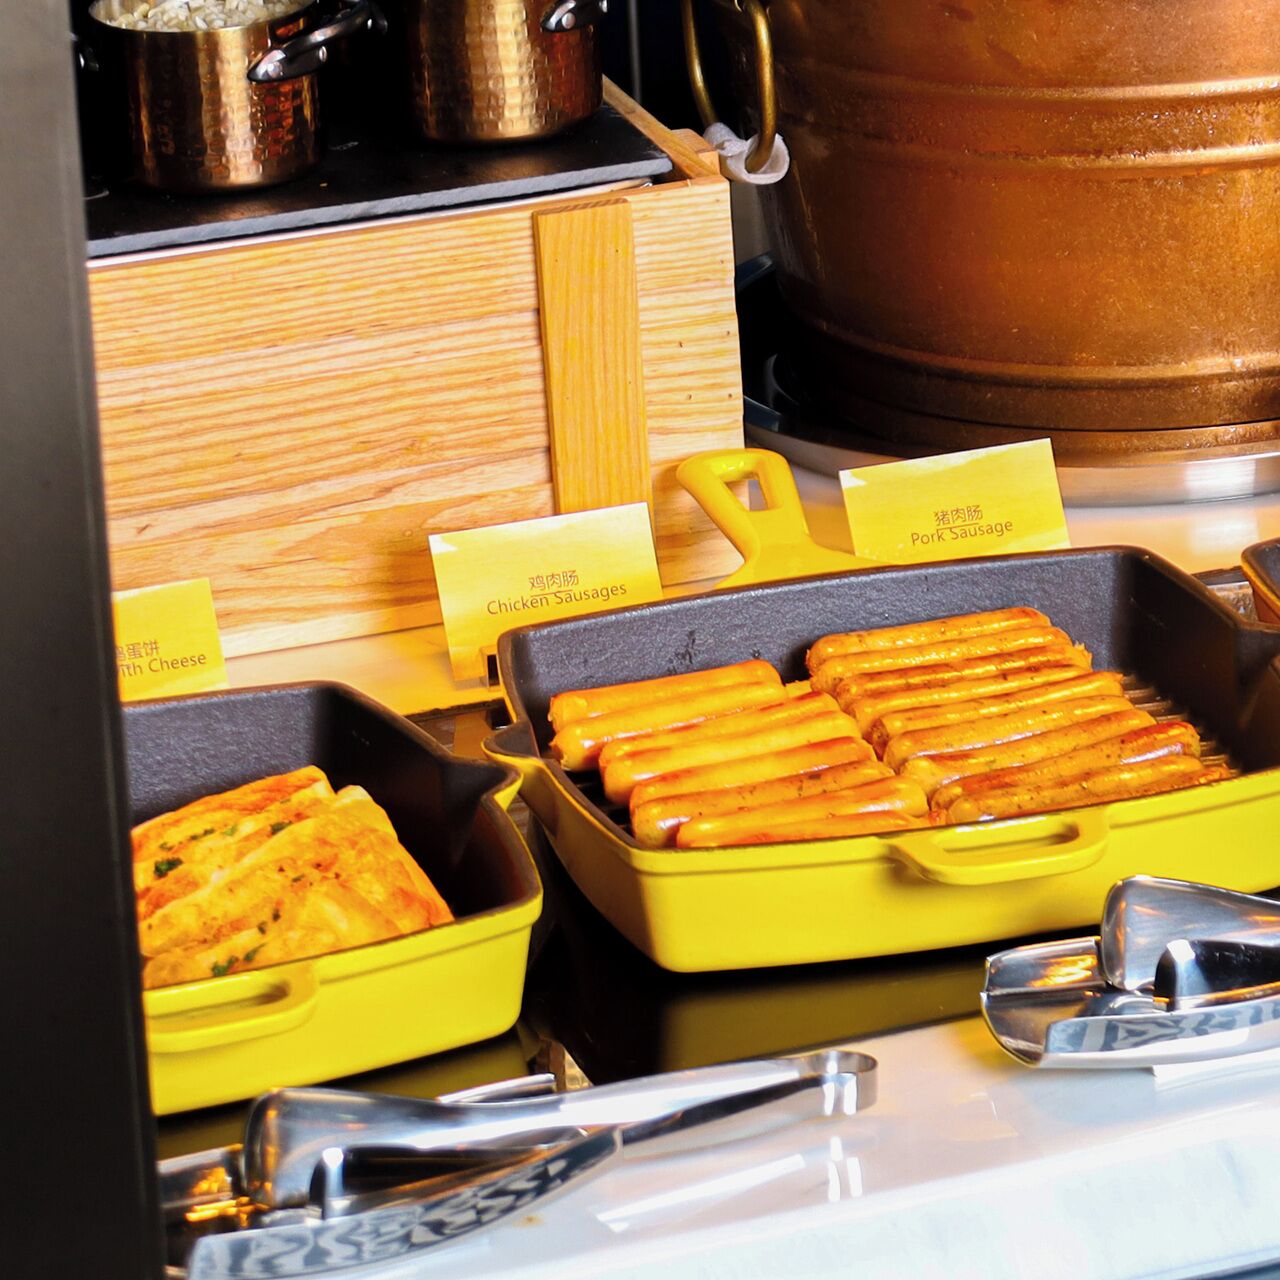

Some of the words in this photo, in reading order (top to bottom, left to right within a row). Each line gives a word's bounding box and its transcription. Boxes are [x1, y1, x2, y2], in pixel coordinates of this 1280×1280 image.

[933, 504, 984, 526] 猪肉肠
[911, 528, 945, 546] Pork
[950, 519, 1014, 541] Sausage
[528, 570, 579, 591] 鸡肉肠
[486, 592, 550, 616] Chicken
[555, 583, 628, 605] Sausages
[118, 662, 144, 678] ith
[148, 653, 207, 673] Cheese
